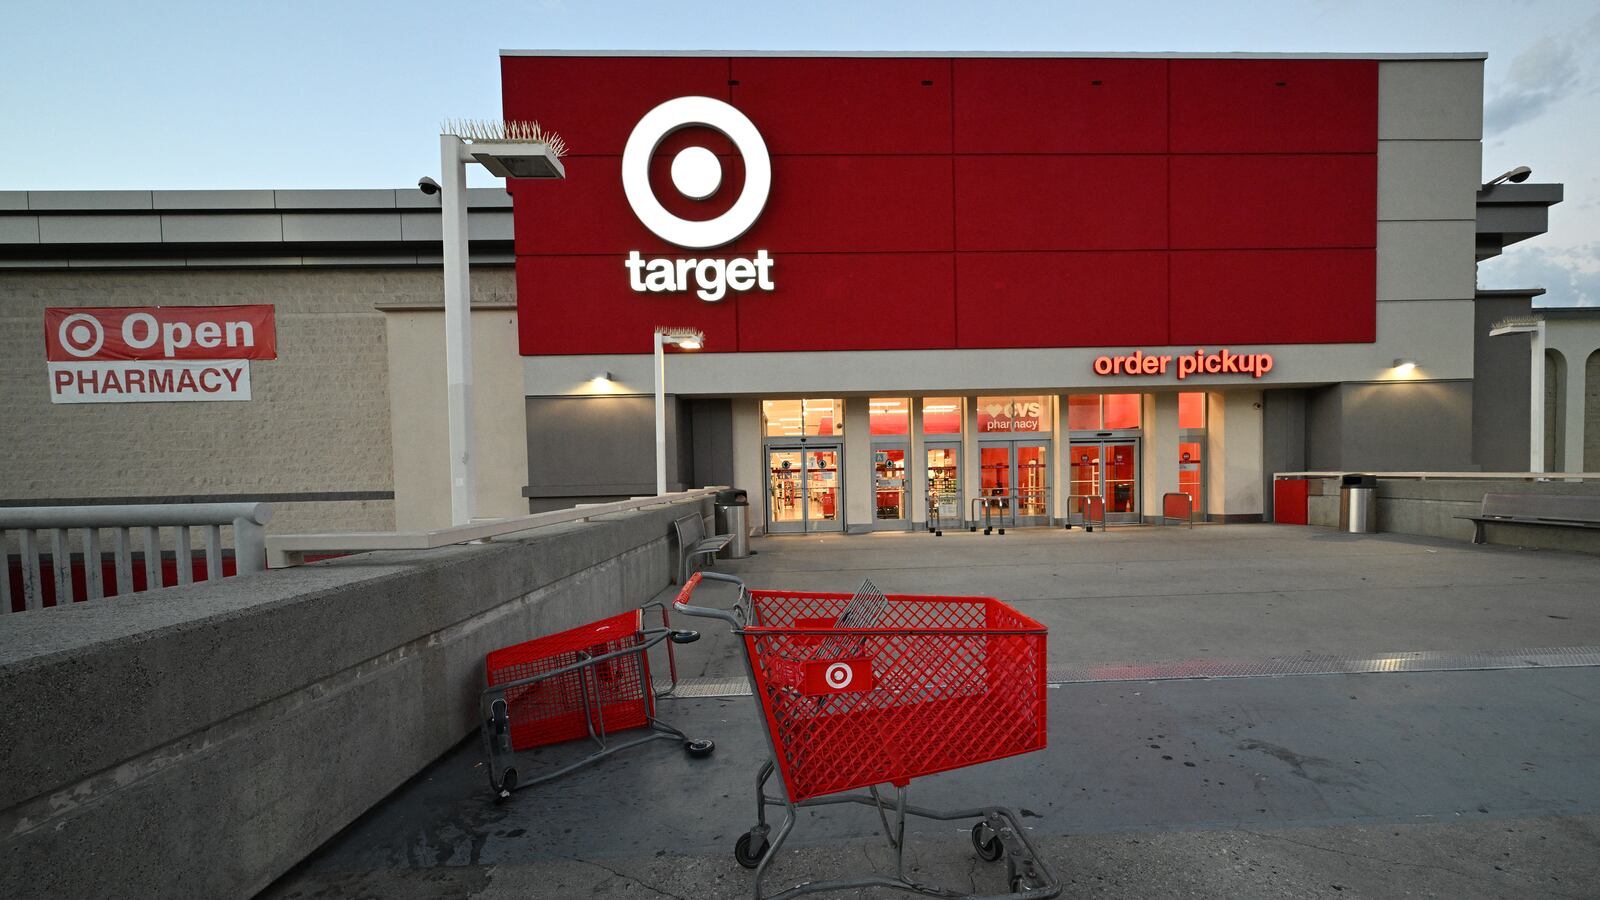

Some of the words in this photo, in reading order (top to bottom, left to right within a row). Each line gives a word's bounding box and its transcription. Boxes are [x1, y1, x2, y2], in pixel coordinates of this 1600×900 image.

[624, 249, 775, 302] target
[121, 312, 255, 357] Open
[1093, 350, 1172, 375] order
[1177, 348, 1274, 380] pickup
[54, 367, 243, 395] PHARMACY
[1003, 402, 1041, 418] CVS
